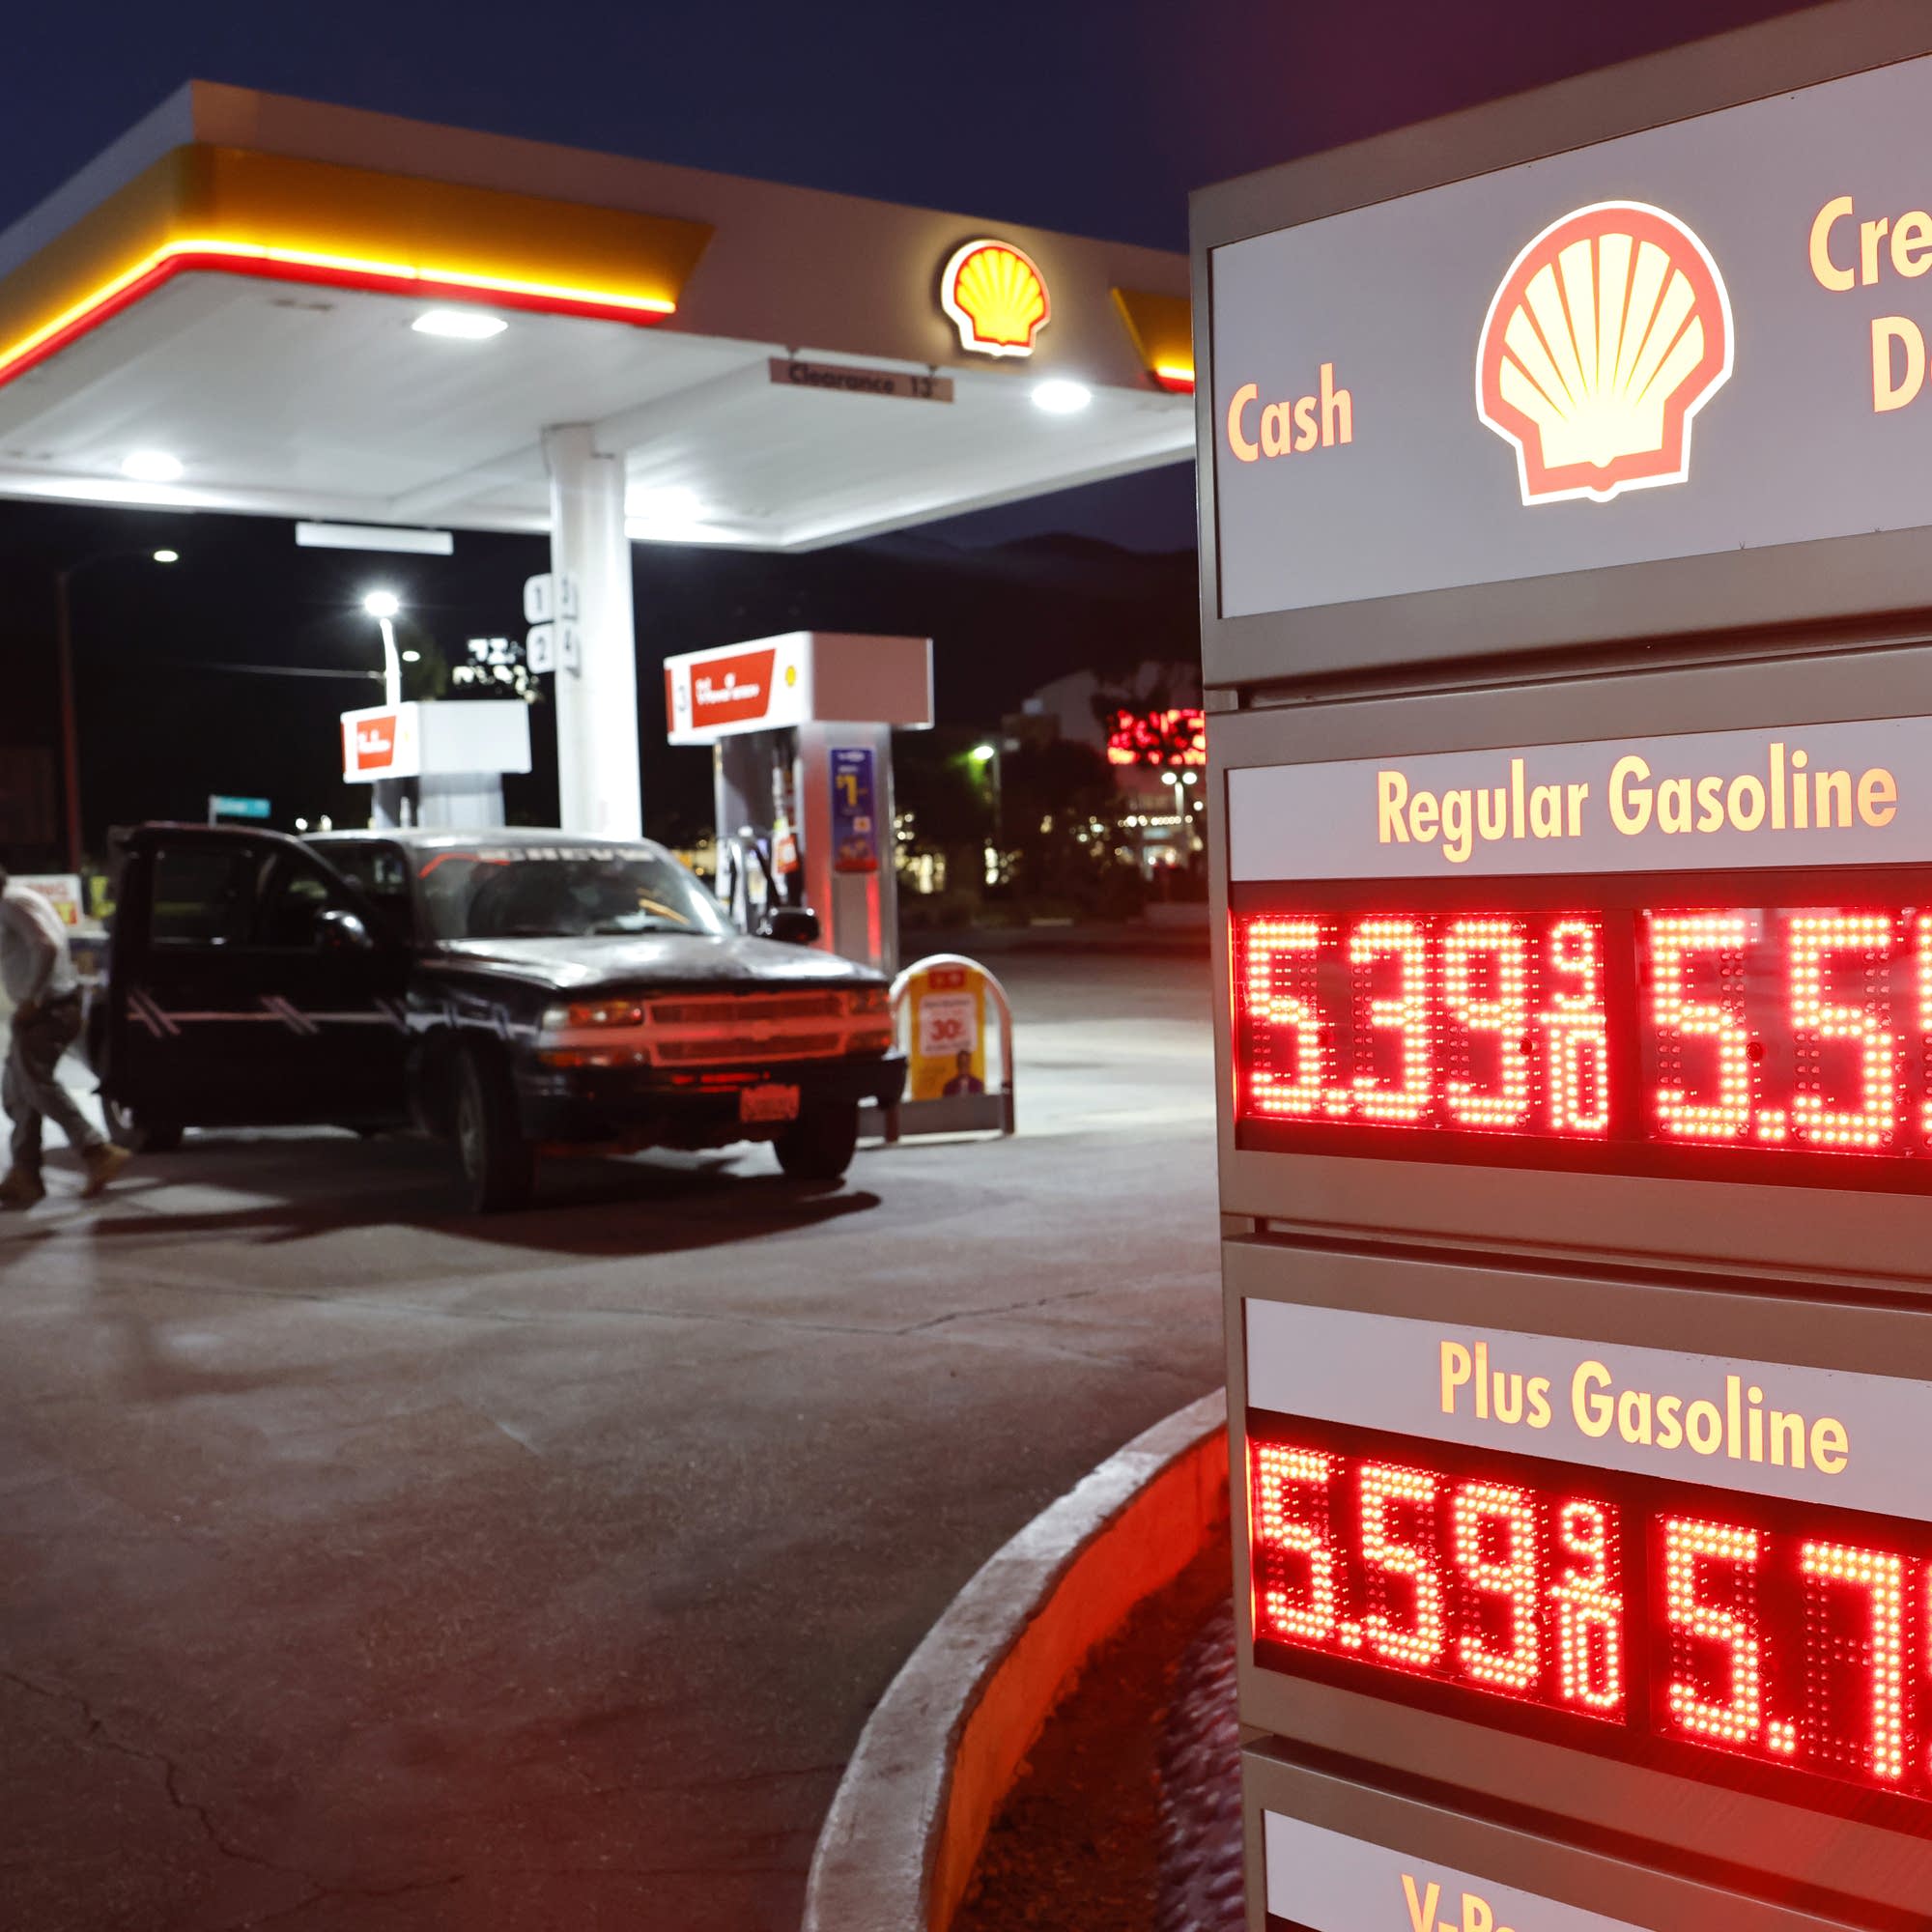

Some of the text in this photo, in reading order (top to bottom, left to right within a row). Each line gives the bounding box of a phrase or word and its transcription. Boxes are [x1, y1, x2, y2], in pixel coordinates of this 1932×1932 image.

[789, 362, 895, 394] Clearance
[1227, 362, 1352, 463] Cash
[1871, 315, 1932, 413] D
[1378, 742, 1898, 863] Regular Gasoline
[1246, 921, 1532, 1126] 5.39
[1649, 916, 1932, 1148] 5.5
[1440, 1341, 1849, 1475] Plus Gasoline
[1259, 1447, 1539, 1690] 5.59
[1665, 1518, 1932, 1777] 5.7
[1401, 1873, 1517, 1932] V-P
